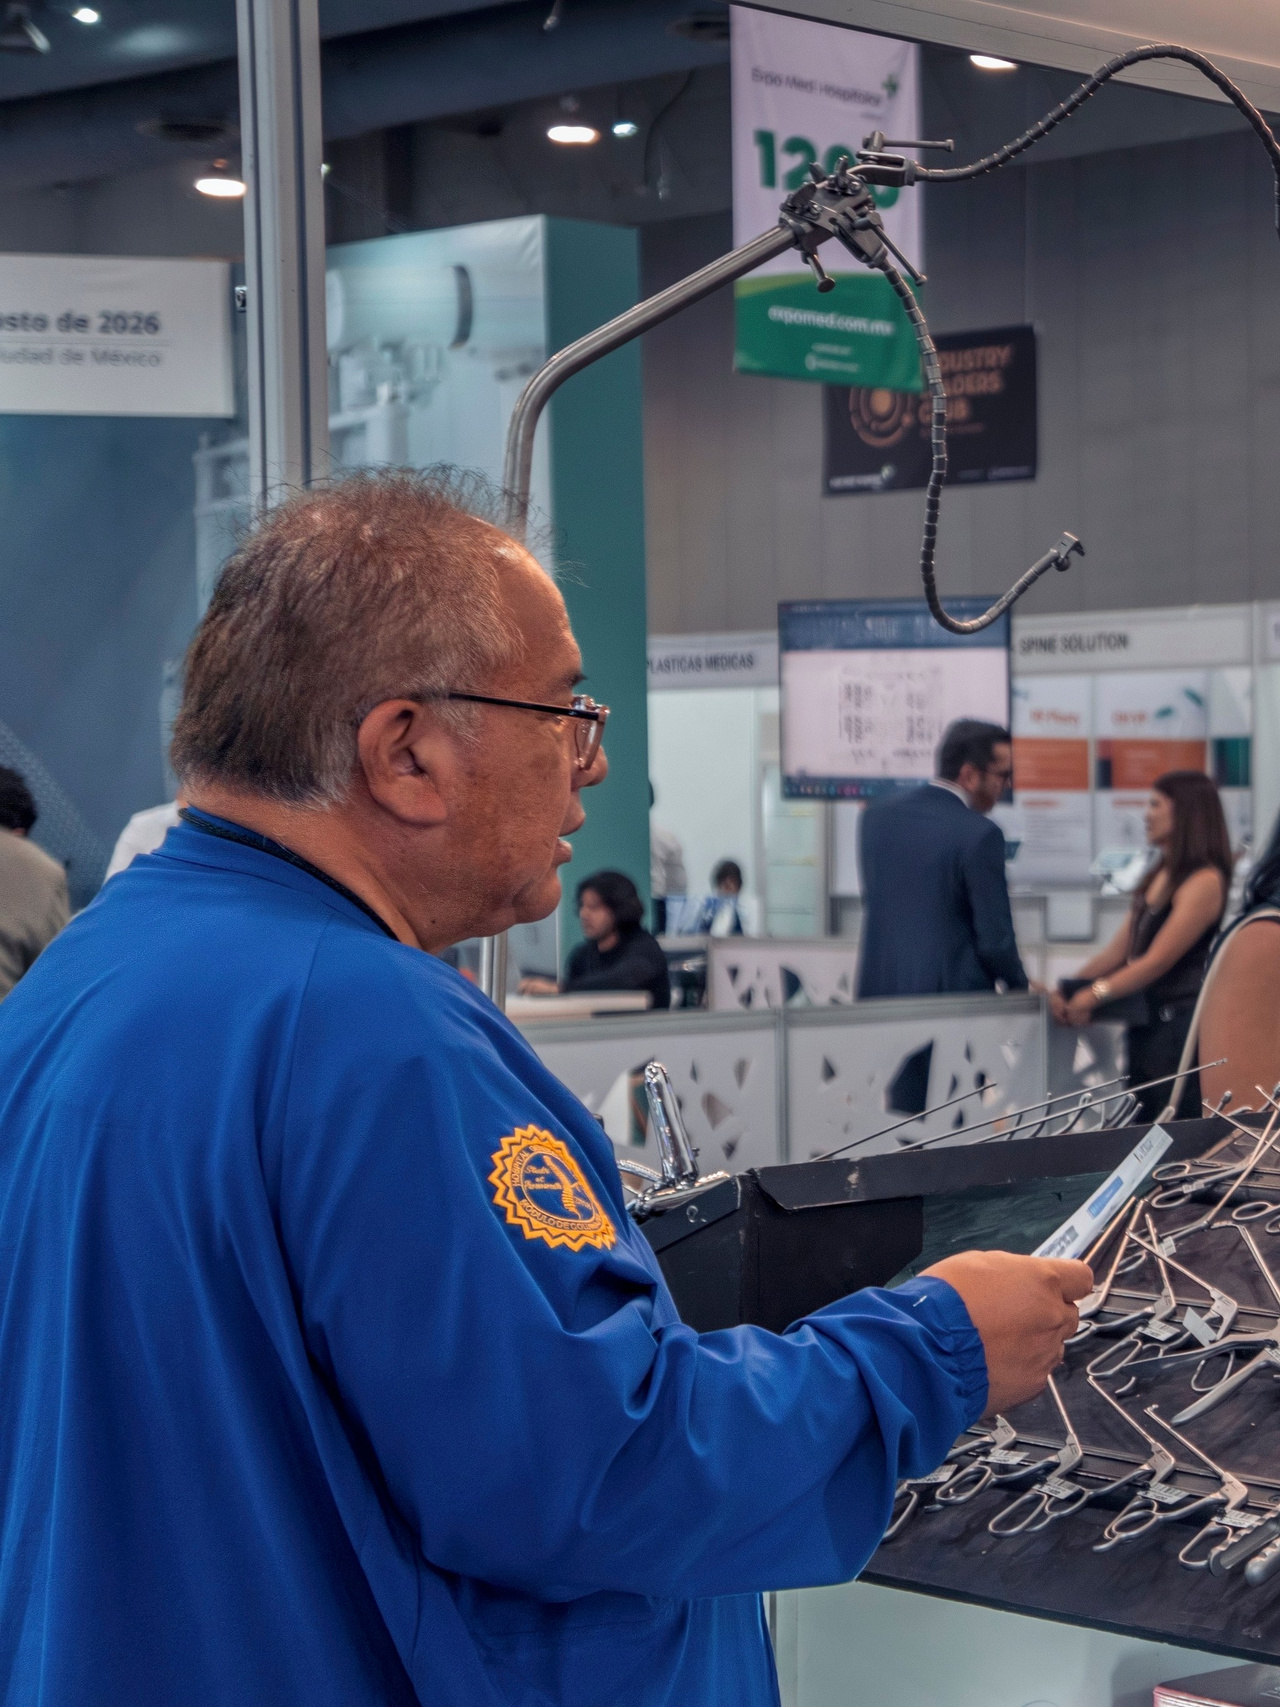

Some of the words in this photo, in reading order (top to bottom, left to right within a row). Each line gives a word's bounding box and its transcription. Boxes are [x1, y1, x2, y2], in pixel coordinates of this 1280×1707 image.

[0, 310, 48, 333] sto
[57, 309, 90, 334] de
[98, 309, 161, 335] 2026
[937, 344, 1012, 374] DUSTRY
[1020, 635, 1057, 655] SPINE
[1060, 631, 1129, 653] SOLUTION
[647, 654, 702, 674] LASTICAS
